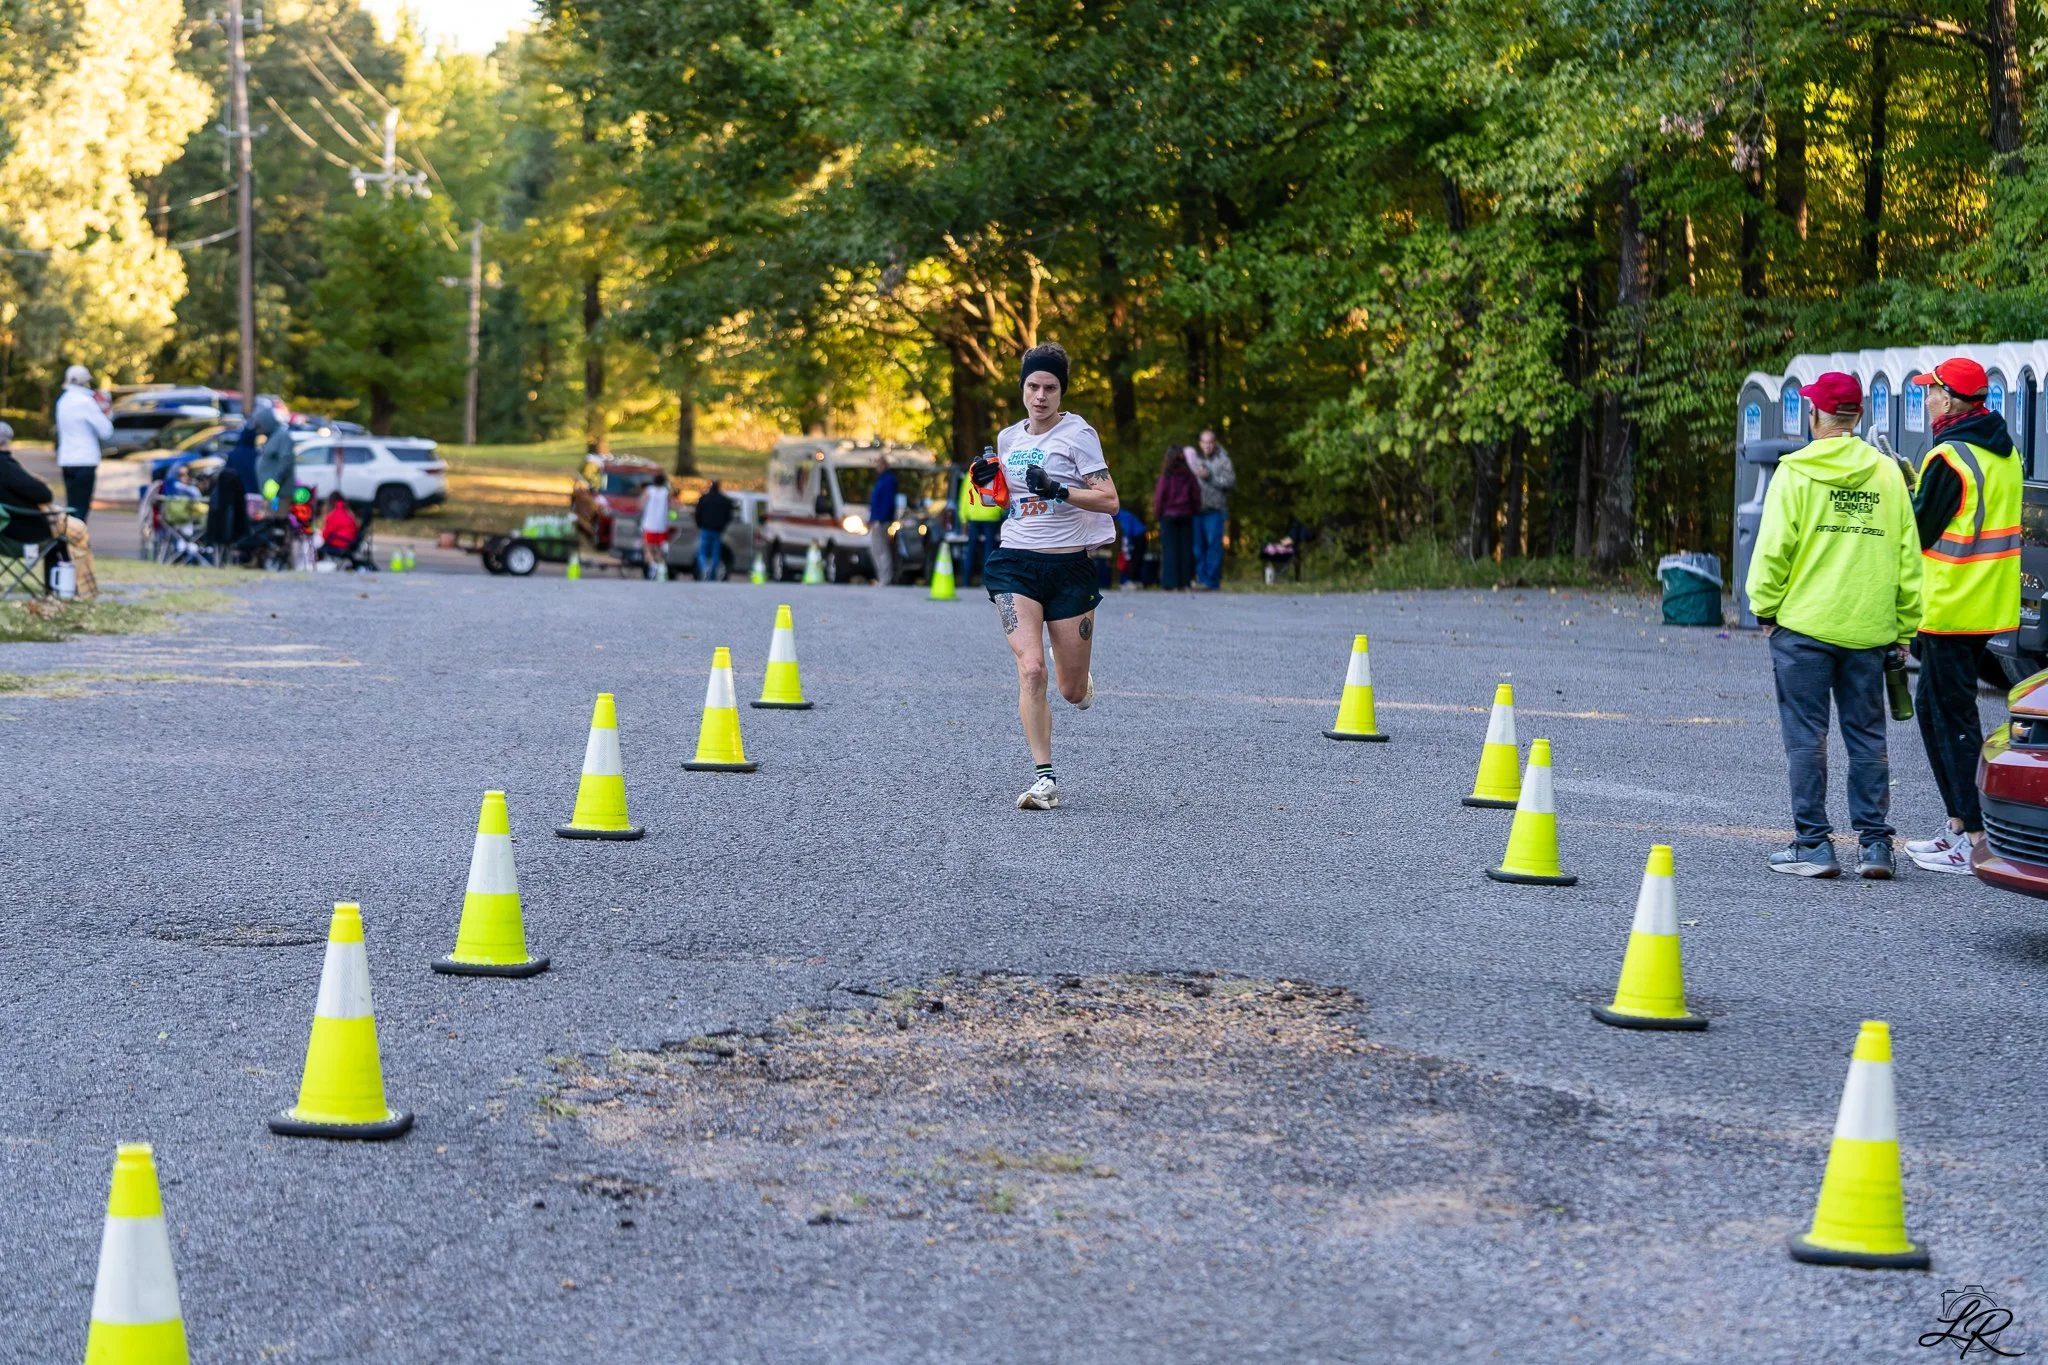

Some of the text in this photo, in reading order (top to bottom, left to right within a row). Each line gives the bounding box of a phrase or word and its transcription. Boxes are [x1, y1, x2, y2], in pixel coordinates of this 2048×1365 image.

[1829, 490, 1880, 504] MEMPHIS
[1021, 502, 1047, 516] 229
[1834, 501, 1873, 511] RUNNERS
[1841, 525, 1861, 534] LINE
[1861, 528, 1885, 536] CREW
[1948, 852, 1965, 864] N
